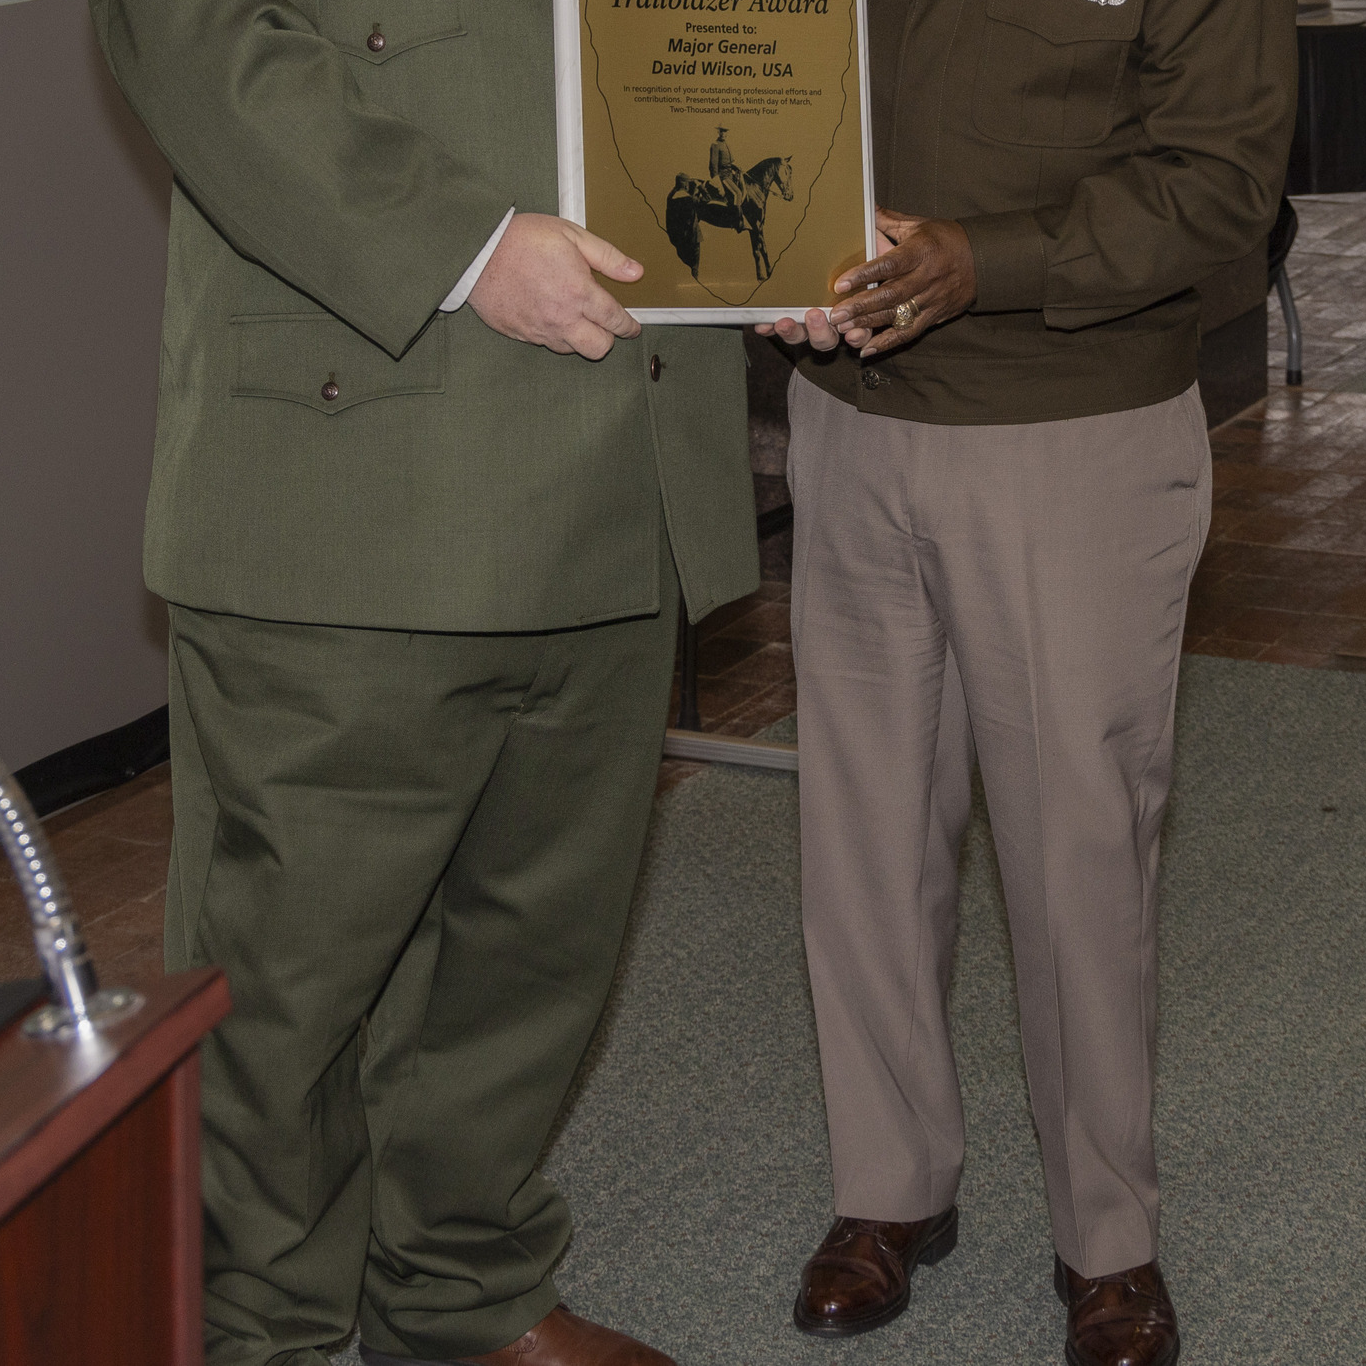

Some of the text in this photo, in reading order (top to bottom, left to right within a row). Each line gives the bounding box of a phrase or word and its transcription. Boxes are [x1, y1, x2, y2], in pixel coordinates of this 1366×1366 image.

[685, 22, 757, 35] Presented to:
[667, 38, 777, 57] Major General
[651, 60, 794, 78] David Wilson, USA
[623, 85, 631, 93] In
[632, 85, 672, 94] recognition
[673, 86, 681, 94] of
[682, 87, 698, 95] your
[700, 87, 742, 96] outstanding
[743, 87, 784, 97] professional
[785, 88, 807, 96] efforts
[634, 95, 683, 103] contributions.
[685, 96, 720, 104] Presented
[746, 97, 765, 105] Ninth
[766, 98, 779, 106] day
[789, 98, 813, 107] March,
[669, 106, 720, 114] Two-Thousand
[736, 107, 761, 116] Twenty
[762, 107, 779, 115] Four.
